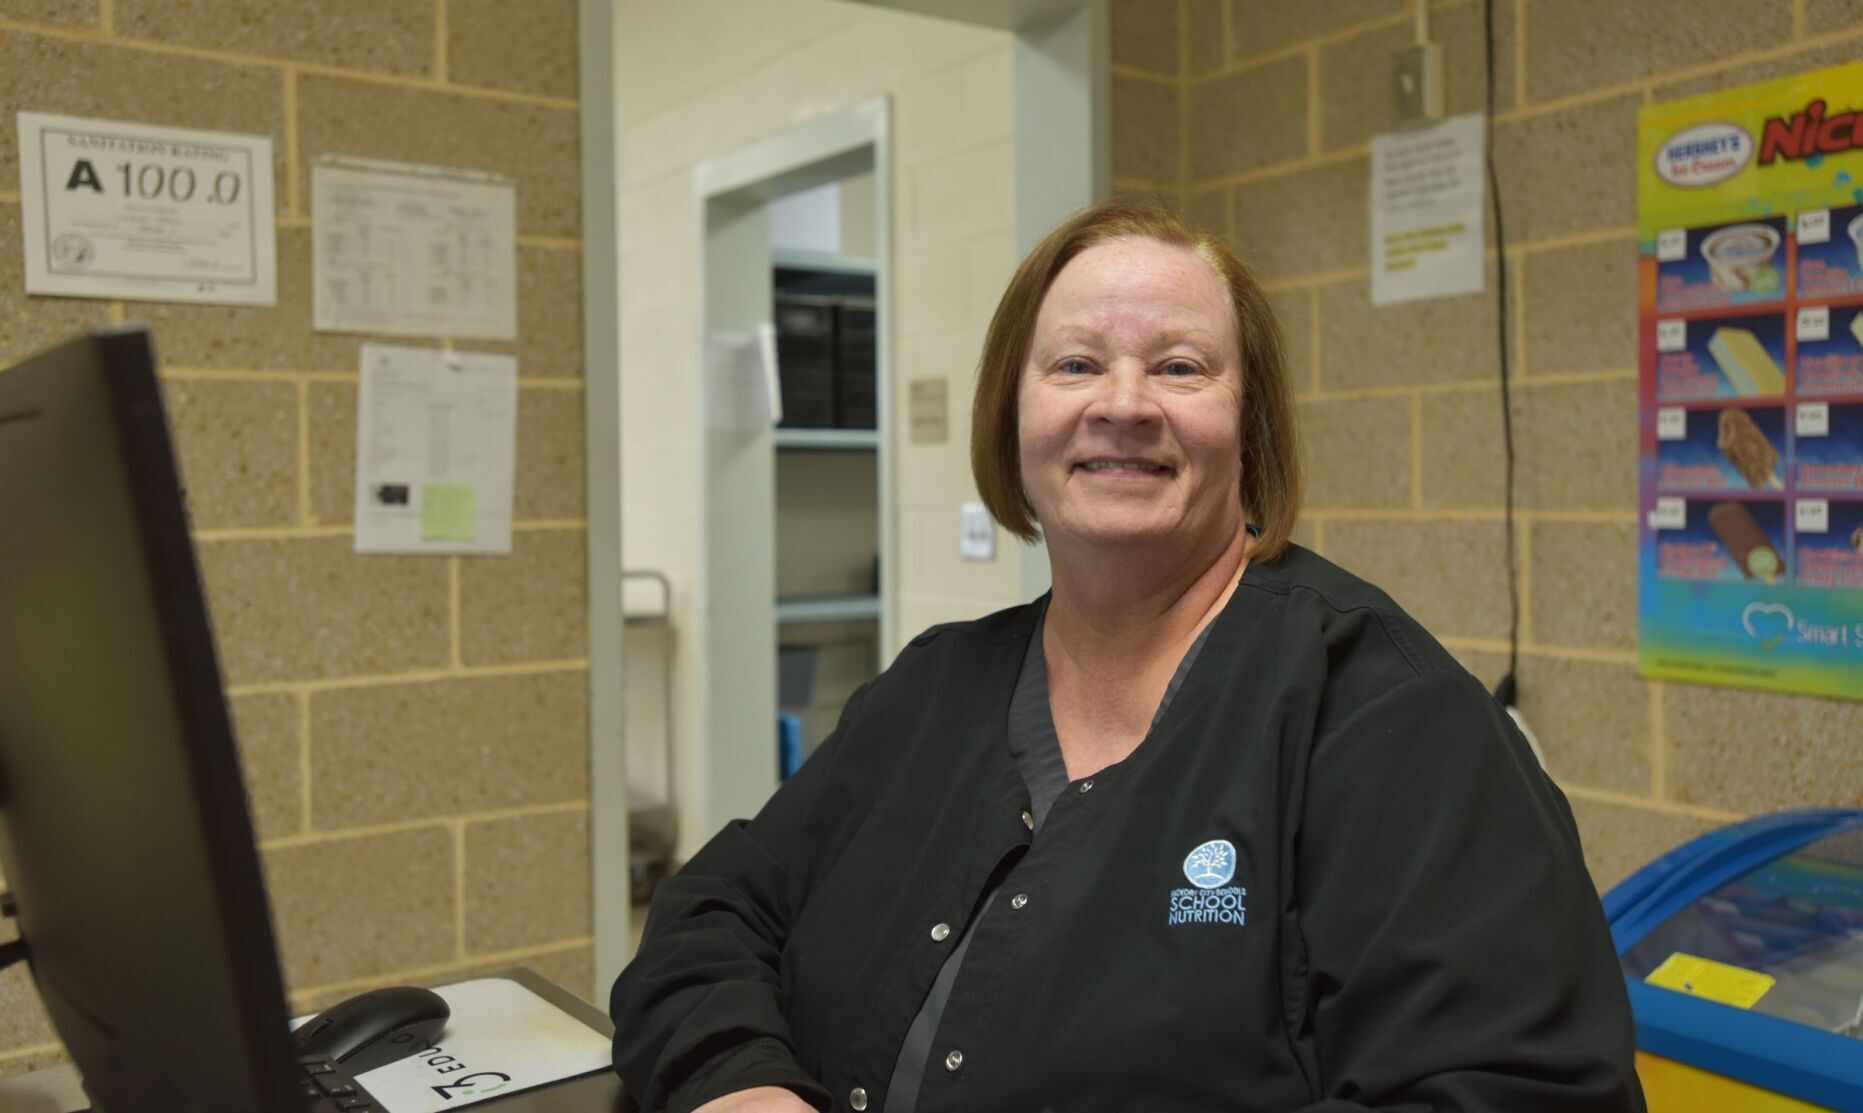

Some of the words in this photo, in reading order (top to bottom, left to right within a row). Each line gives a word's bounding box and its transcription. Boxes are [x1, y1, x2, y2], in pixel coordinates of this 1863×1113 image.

[65, 158, 104, 194] A
[1170, 894, 1247, 912] SCHOOL
[1168, 909, 1245, 926] NUTRITION
